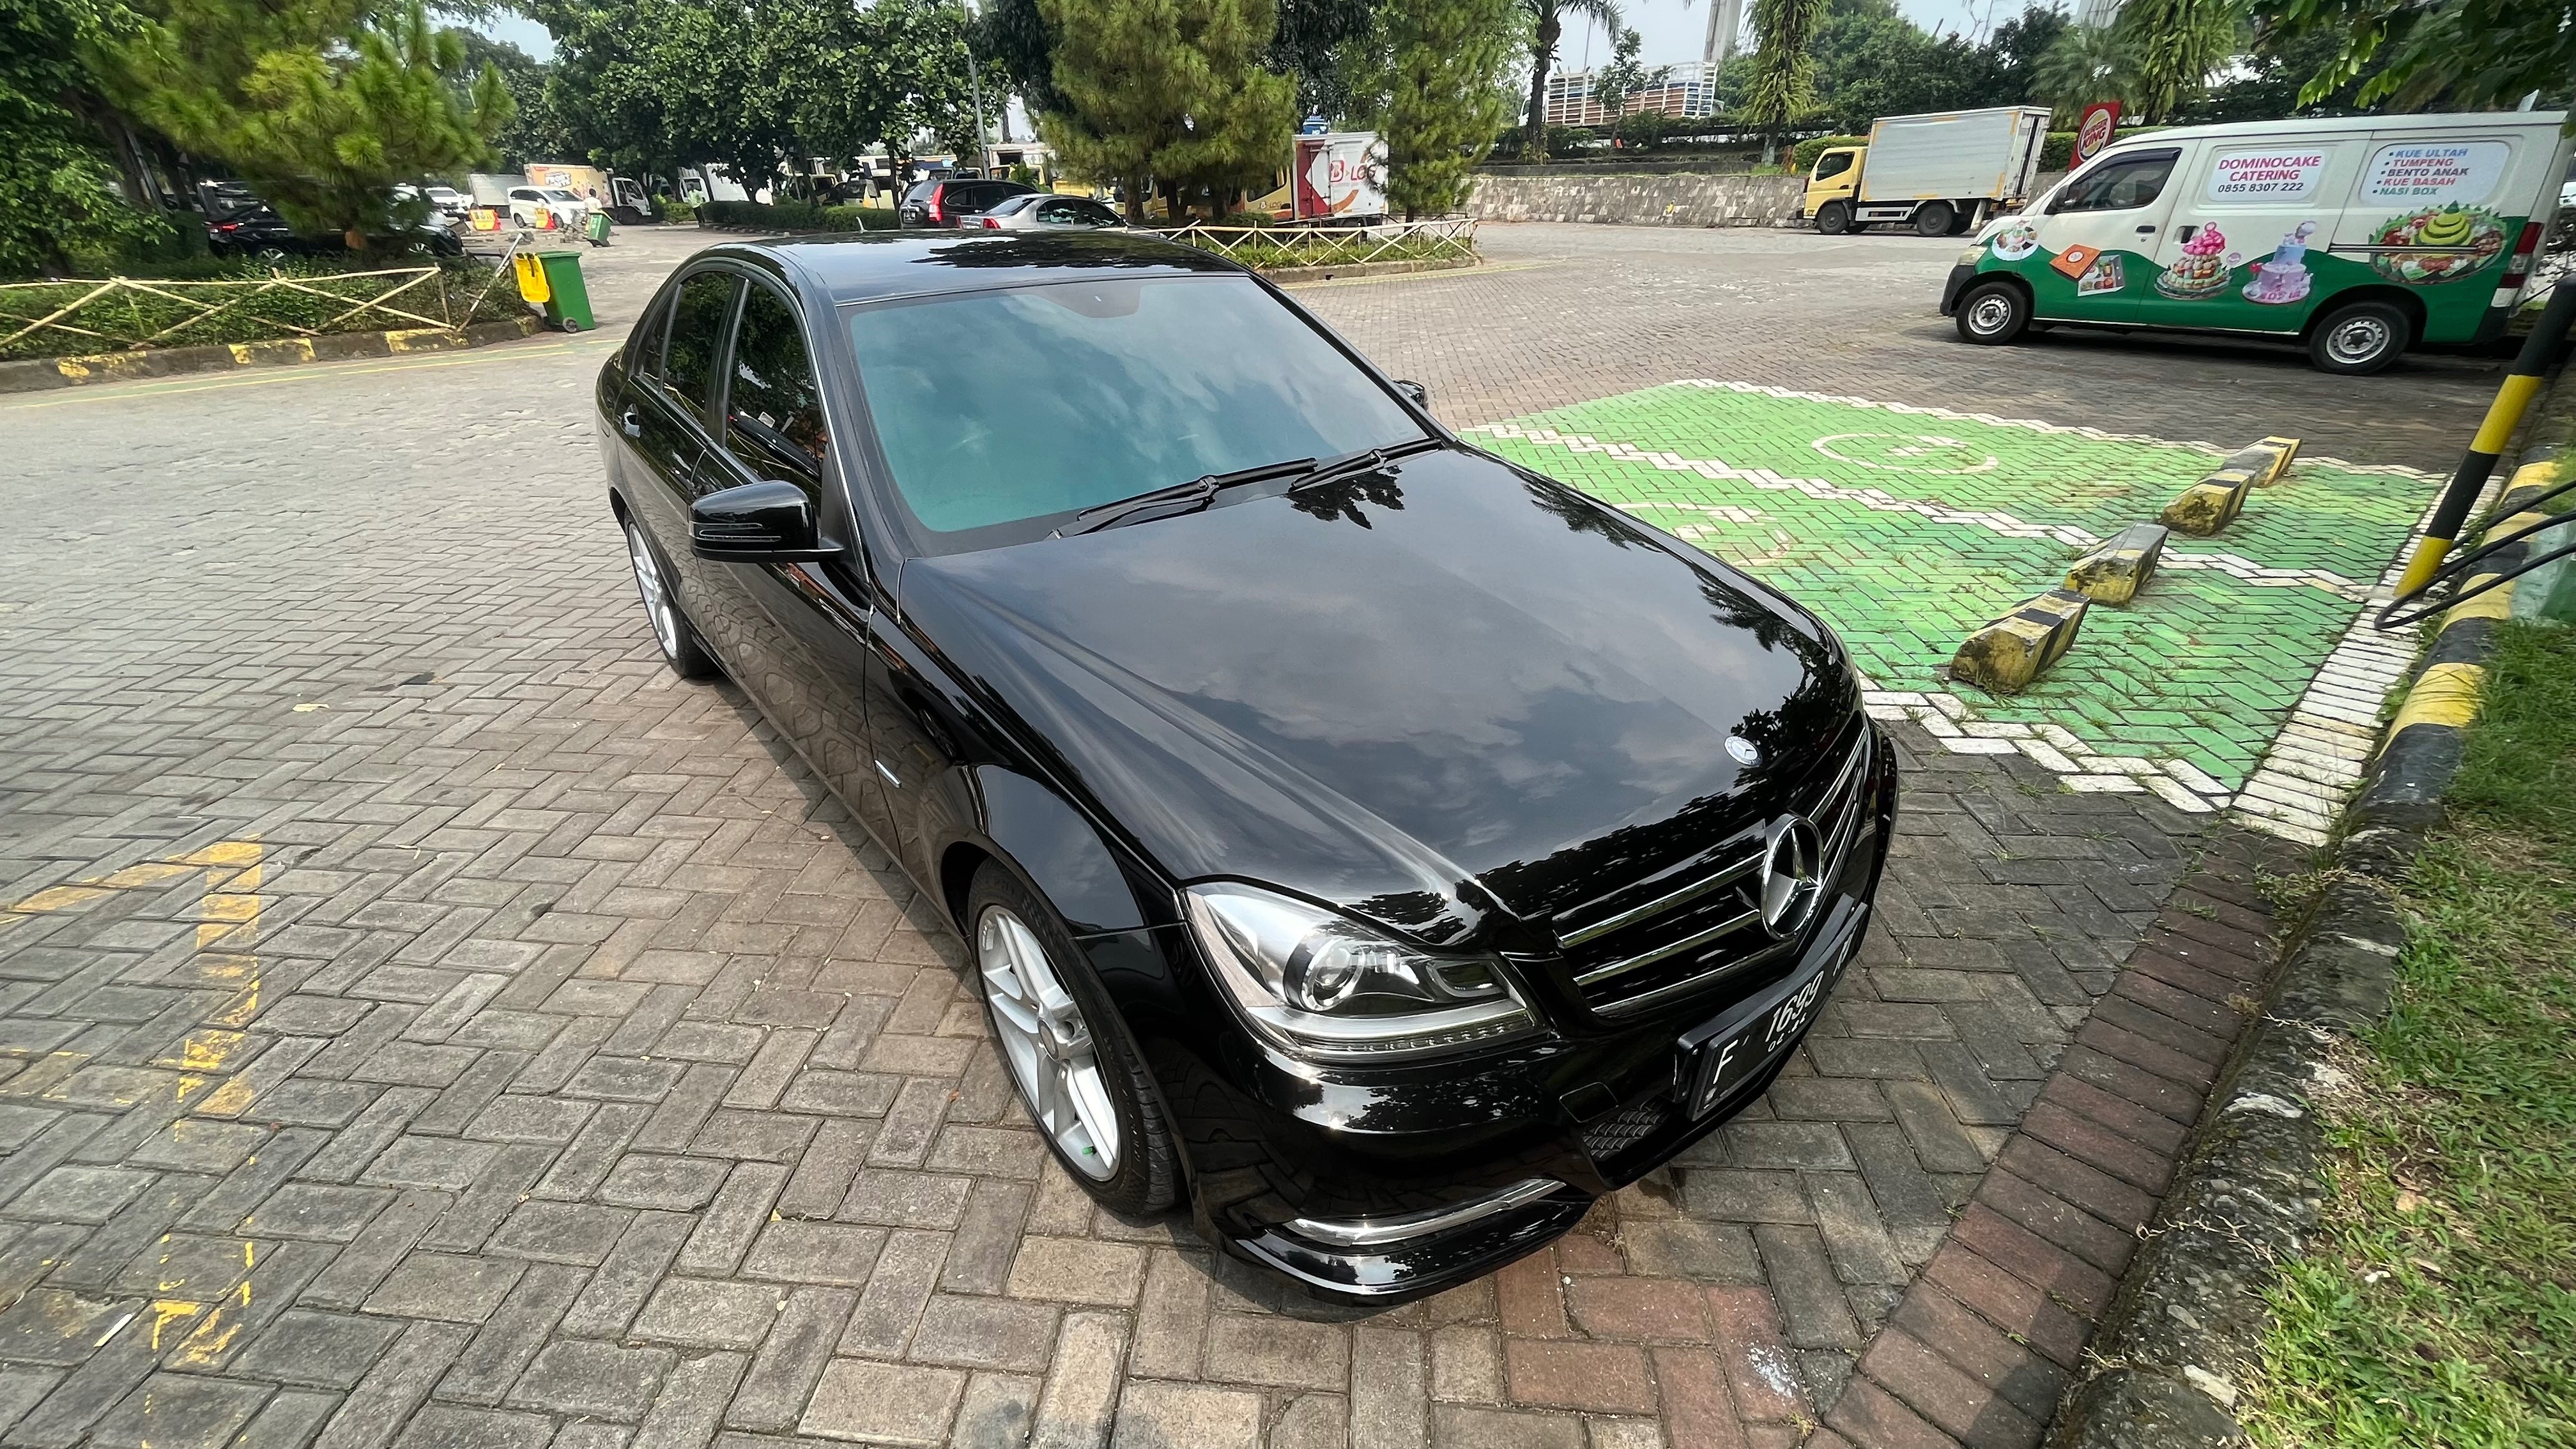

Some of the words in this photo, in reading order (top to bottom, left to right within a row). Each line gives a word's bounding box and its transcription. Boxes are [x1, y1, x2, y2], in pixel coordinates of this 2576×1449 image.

[2083, 127, 2107, 148] KING
[2425, 149, 2468, 157] ULTAH
[2218, 156, 2322, 170] DOMINOCAKE
[2393, 158, 2453, 167] TUMPENG
[2230, 170, 2301, 181] CATERING
[2387, 168, 2429, 176] BENTO
[2432, 167, 2469, 176] ANAK
[2412, 178, 2456, 186] BASAH
[2218, 183, 2246, 193] 0855
[2249, 183, 2278, 192] 8307
[2280, 182, 2304, 191] 222
[2379, 187, 2410, 195] NASI
[2412, 187, 2439, 195] BOX
[1713, 1039, 1738, 1084] F
[1765, 971, 1824, 1042] 1699
